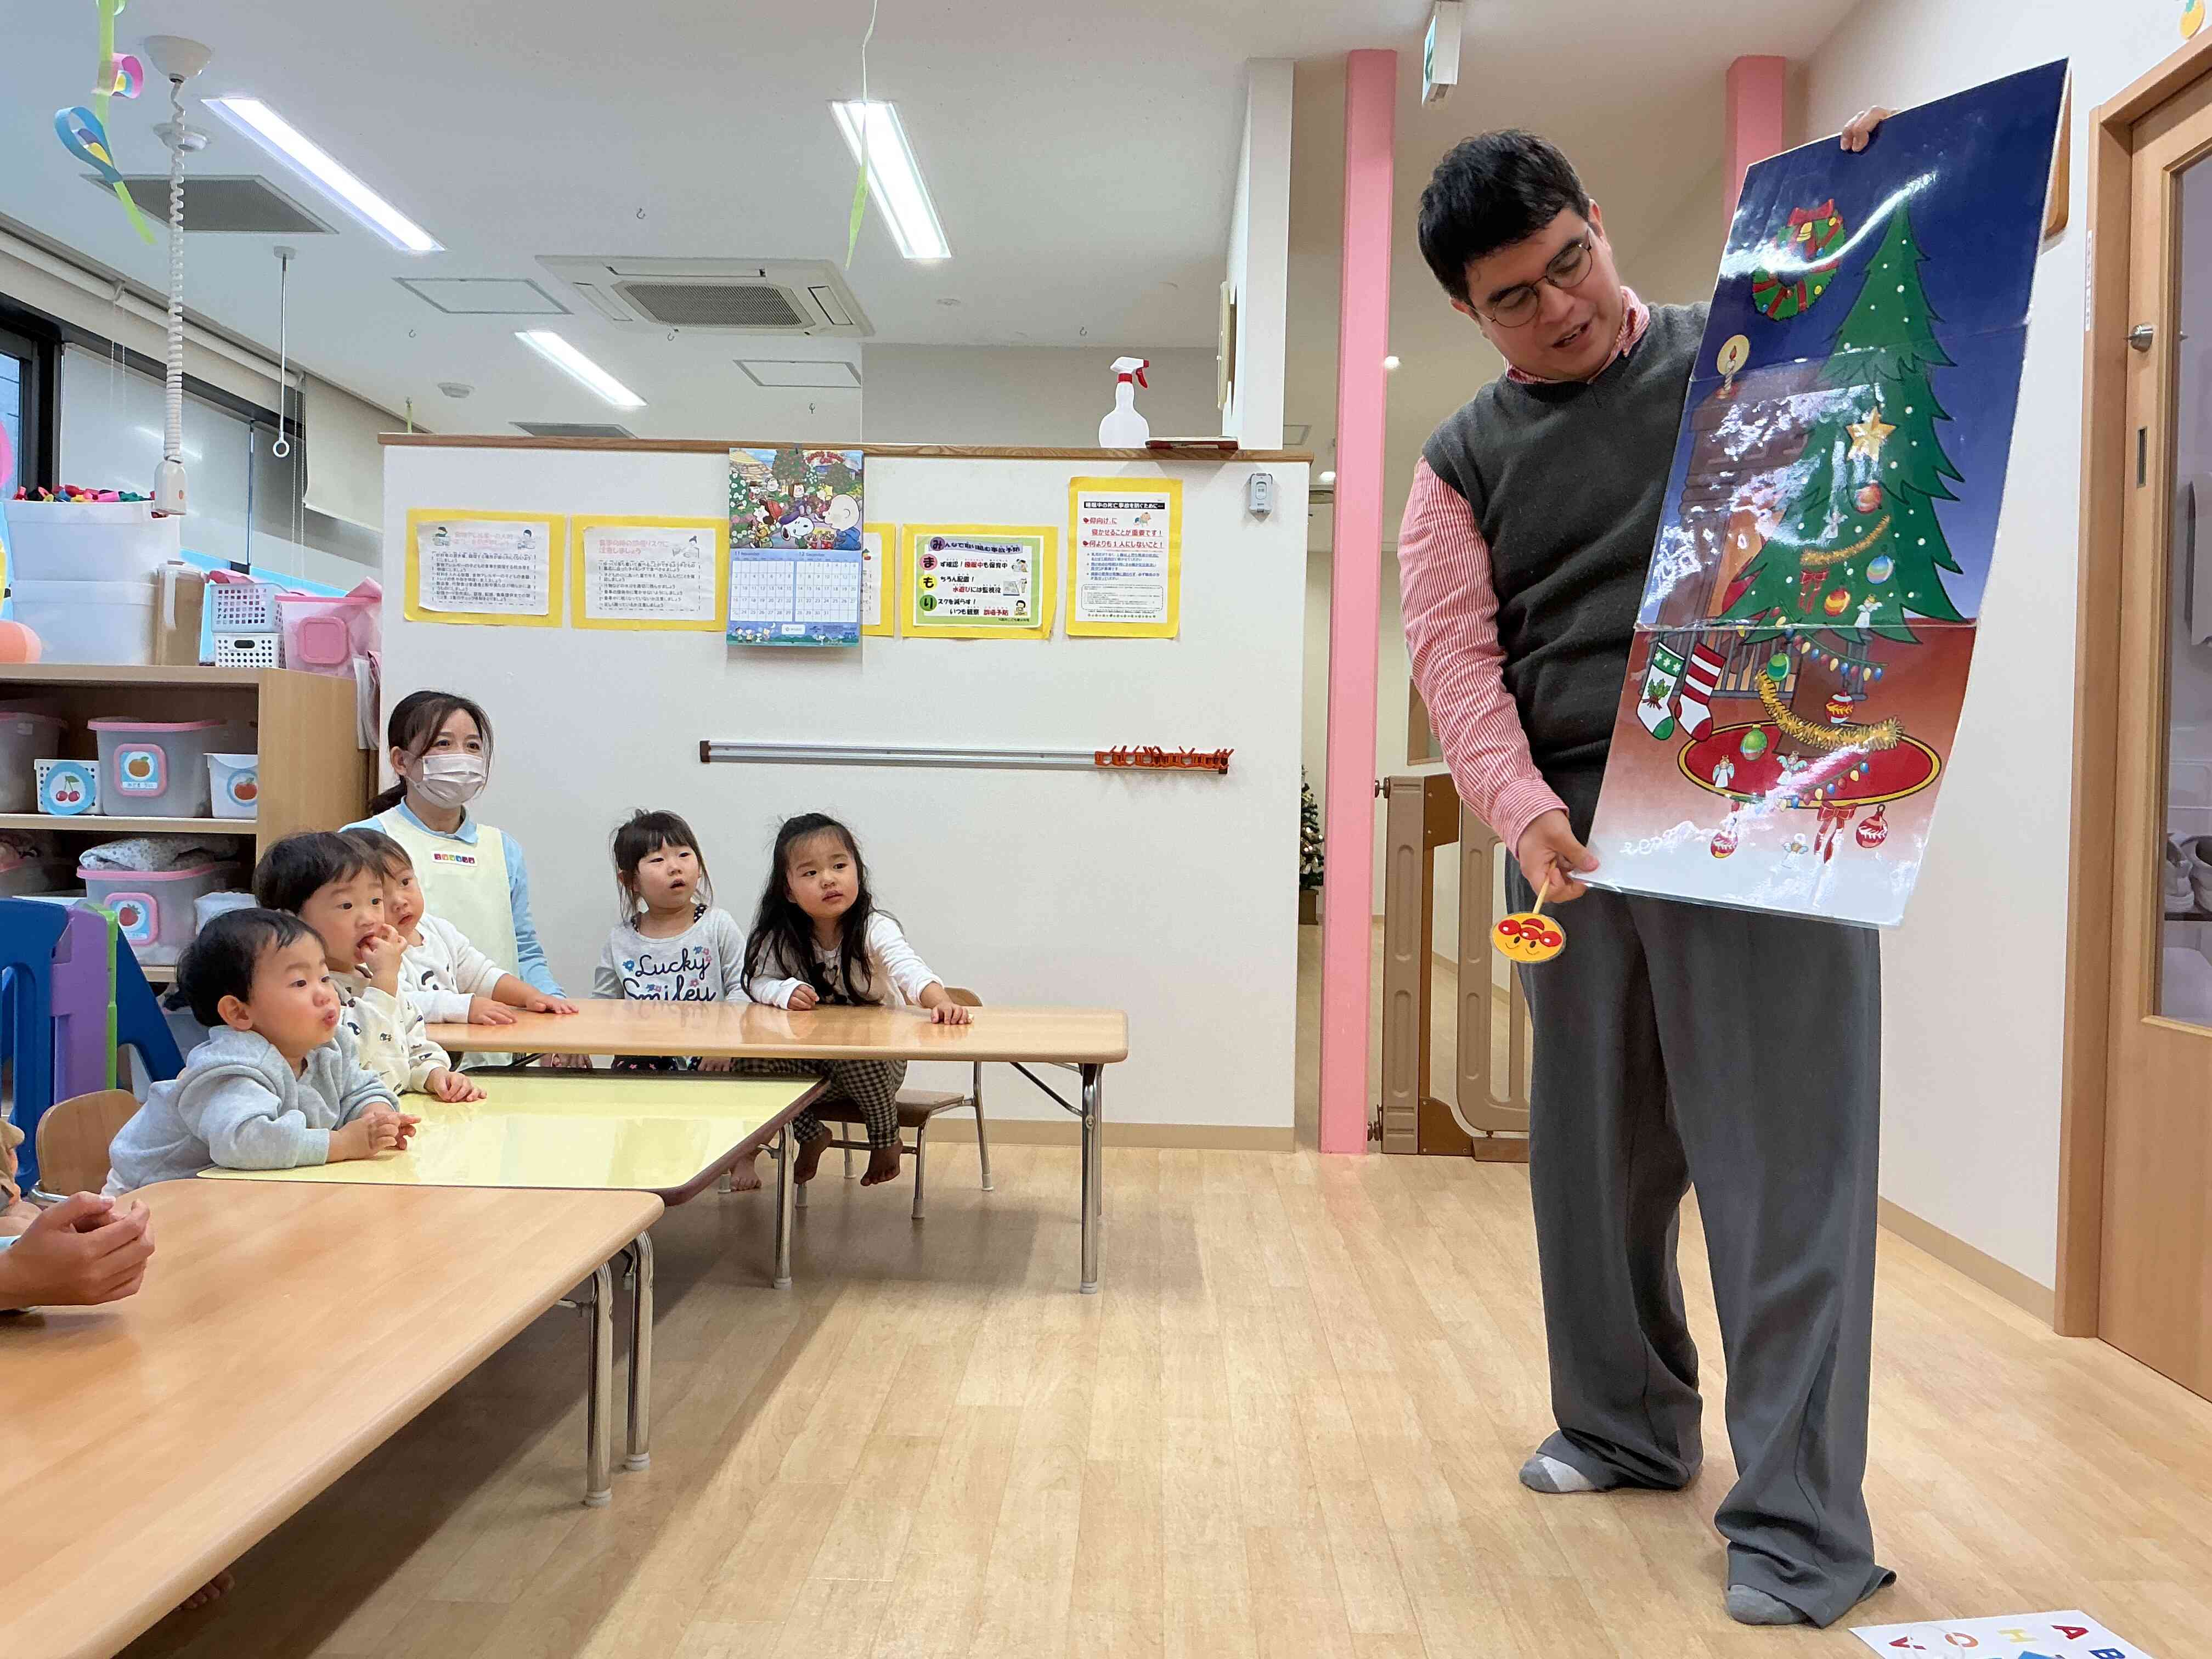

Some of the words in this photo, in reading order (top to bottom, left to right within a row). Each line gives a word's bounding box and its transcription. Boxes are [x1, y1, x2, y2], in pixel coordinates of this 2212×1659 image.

[923, 556, 934, 568] ま
[923, 577, 934, 588] も
[924, 598, 933, 609] り
[635, 948, 710, 980] Lucky
[1997, 1628, 2039, 1643] H
[2051, 1624, 2090, 1640] A
[2089, 1647, 2126, 1659] B
